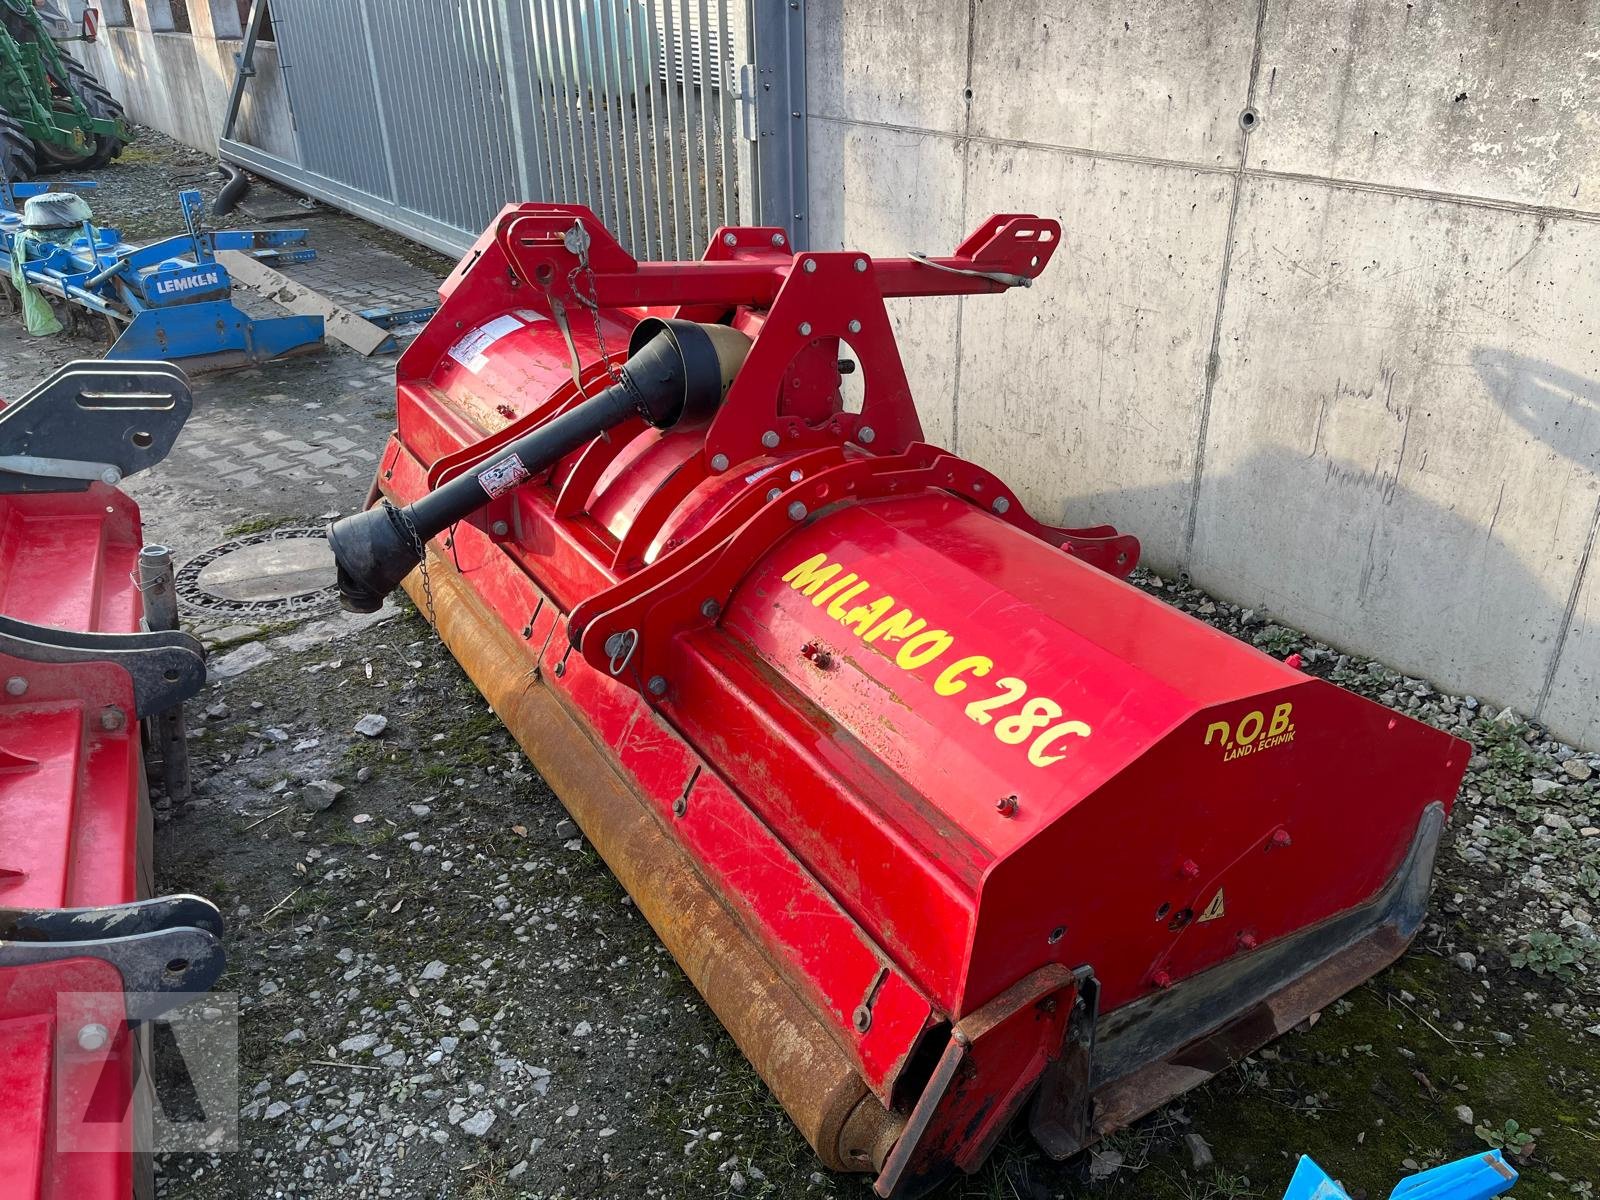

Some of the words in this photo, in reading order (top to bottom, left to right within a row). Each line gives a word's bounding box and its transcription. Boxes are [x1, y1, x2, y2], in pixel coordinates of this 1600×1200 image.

[157, 272, 218, 294] LEMKEN
[781, 553, 954, 670] MILANO
[933, 656, 993, 696] C
[964, 677, 1091, 768] 28C
[1223, 731, 1296, 762] LANDECHNIK
